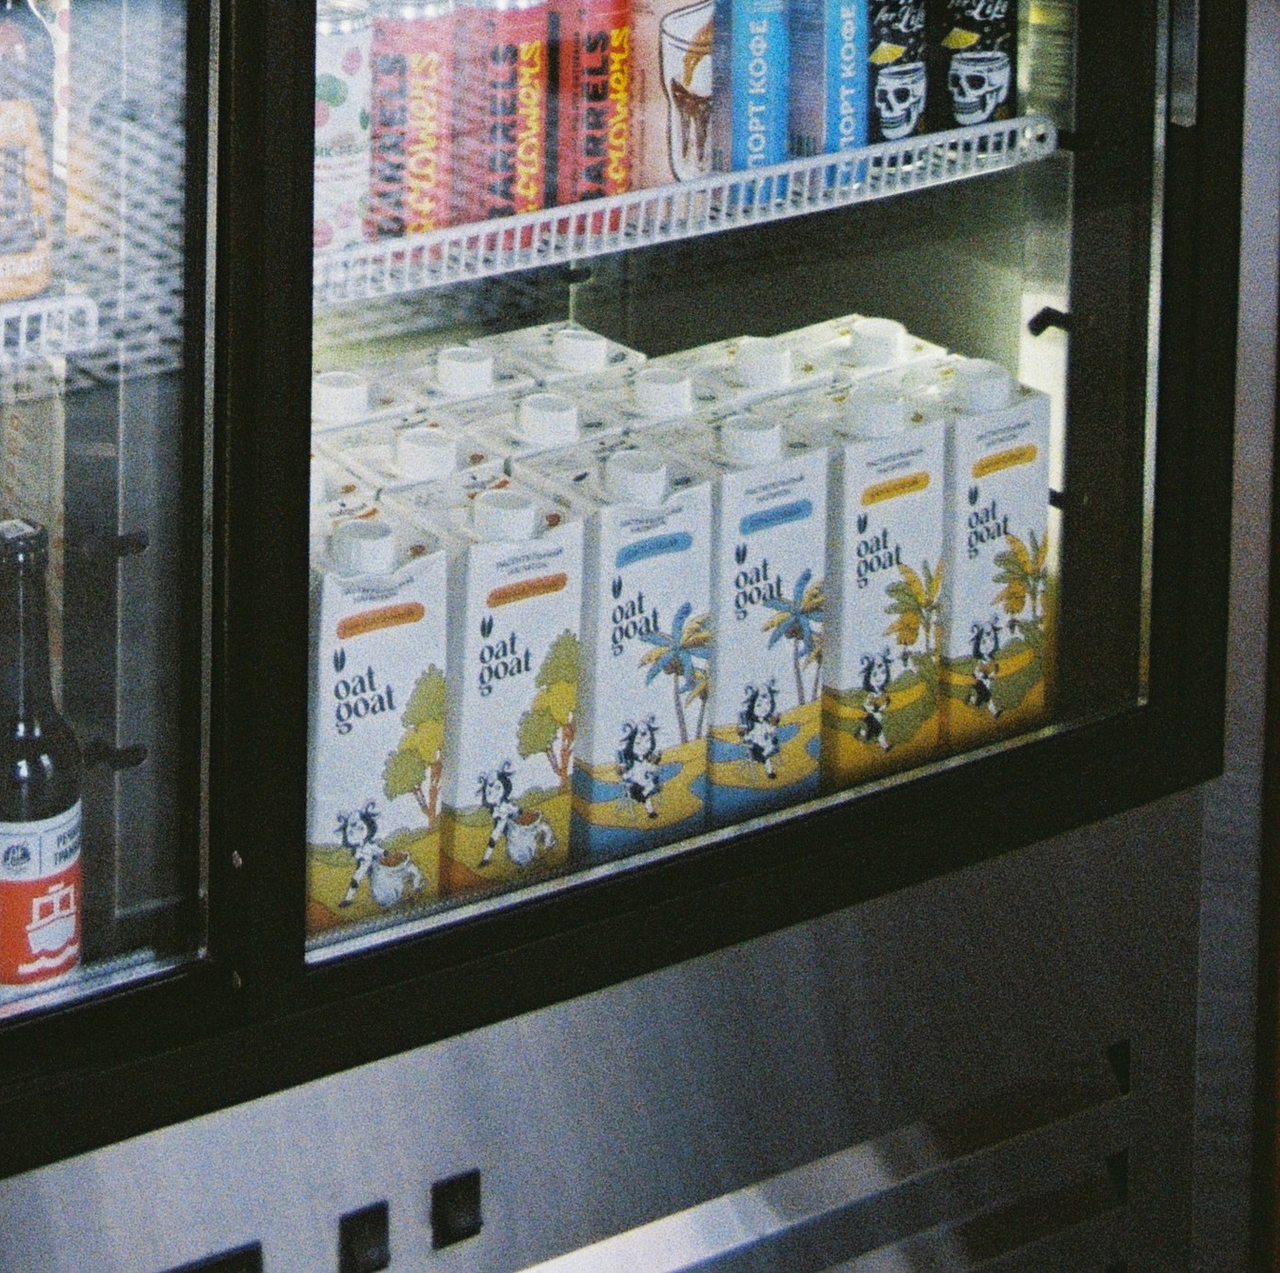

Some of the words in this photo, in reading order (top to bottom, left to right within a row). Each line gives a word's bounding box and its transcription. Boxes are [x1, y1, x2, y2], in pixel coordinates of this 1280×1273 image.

[748, 19, 769, 92] КОФЕ
[840, 2, 858, 83] КОФЕ
[968, 514, 1008, 559] goat
[969, 500, 996, 528] oat
[857, 527, 888, 558] oat
[735, 558, 768, 589] oat
[857, 543, 902, 589] goat
[612, 590, 644, 624] oat
[735, 574, 783, 620] goat
[479, 631, 518, 664] oat
[611, 606, 659, 656] goat
[334, 665, 376, 700] oat
[479, 647, 531, 697] goat
[335, 684, 396, 735] goat
